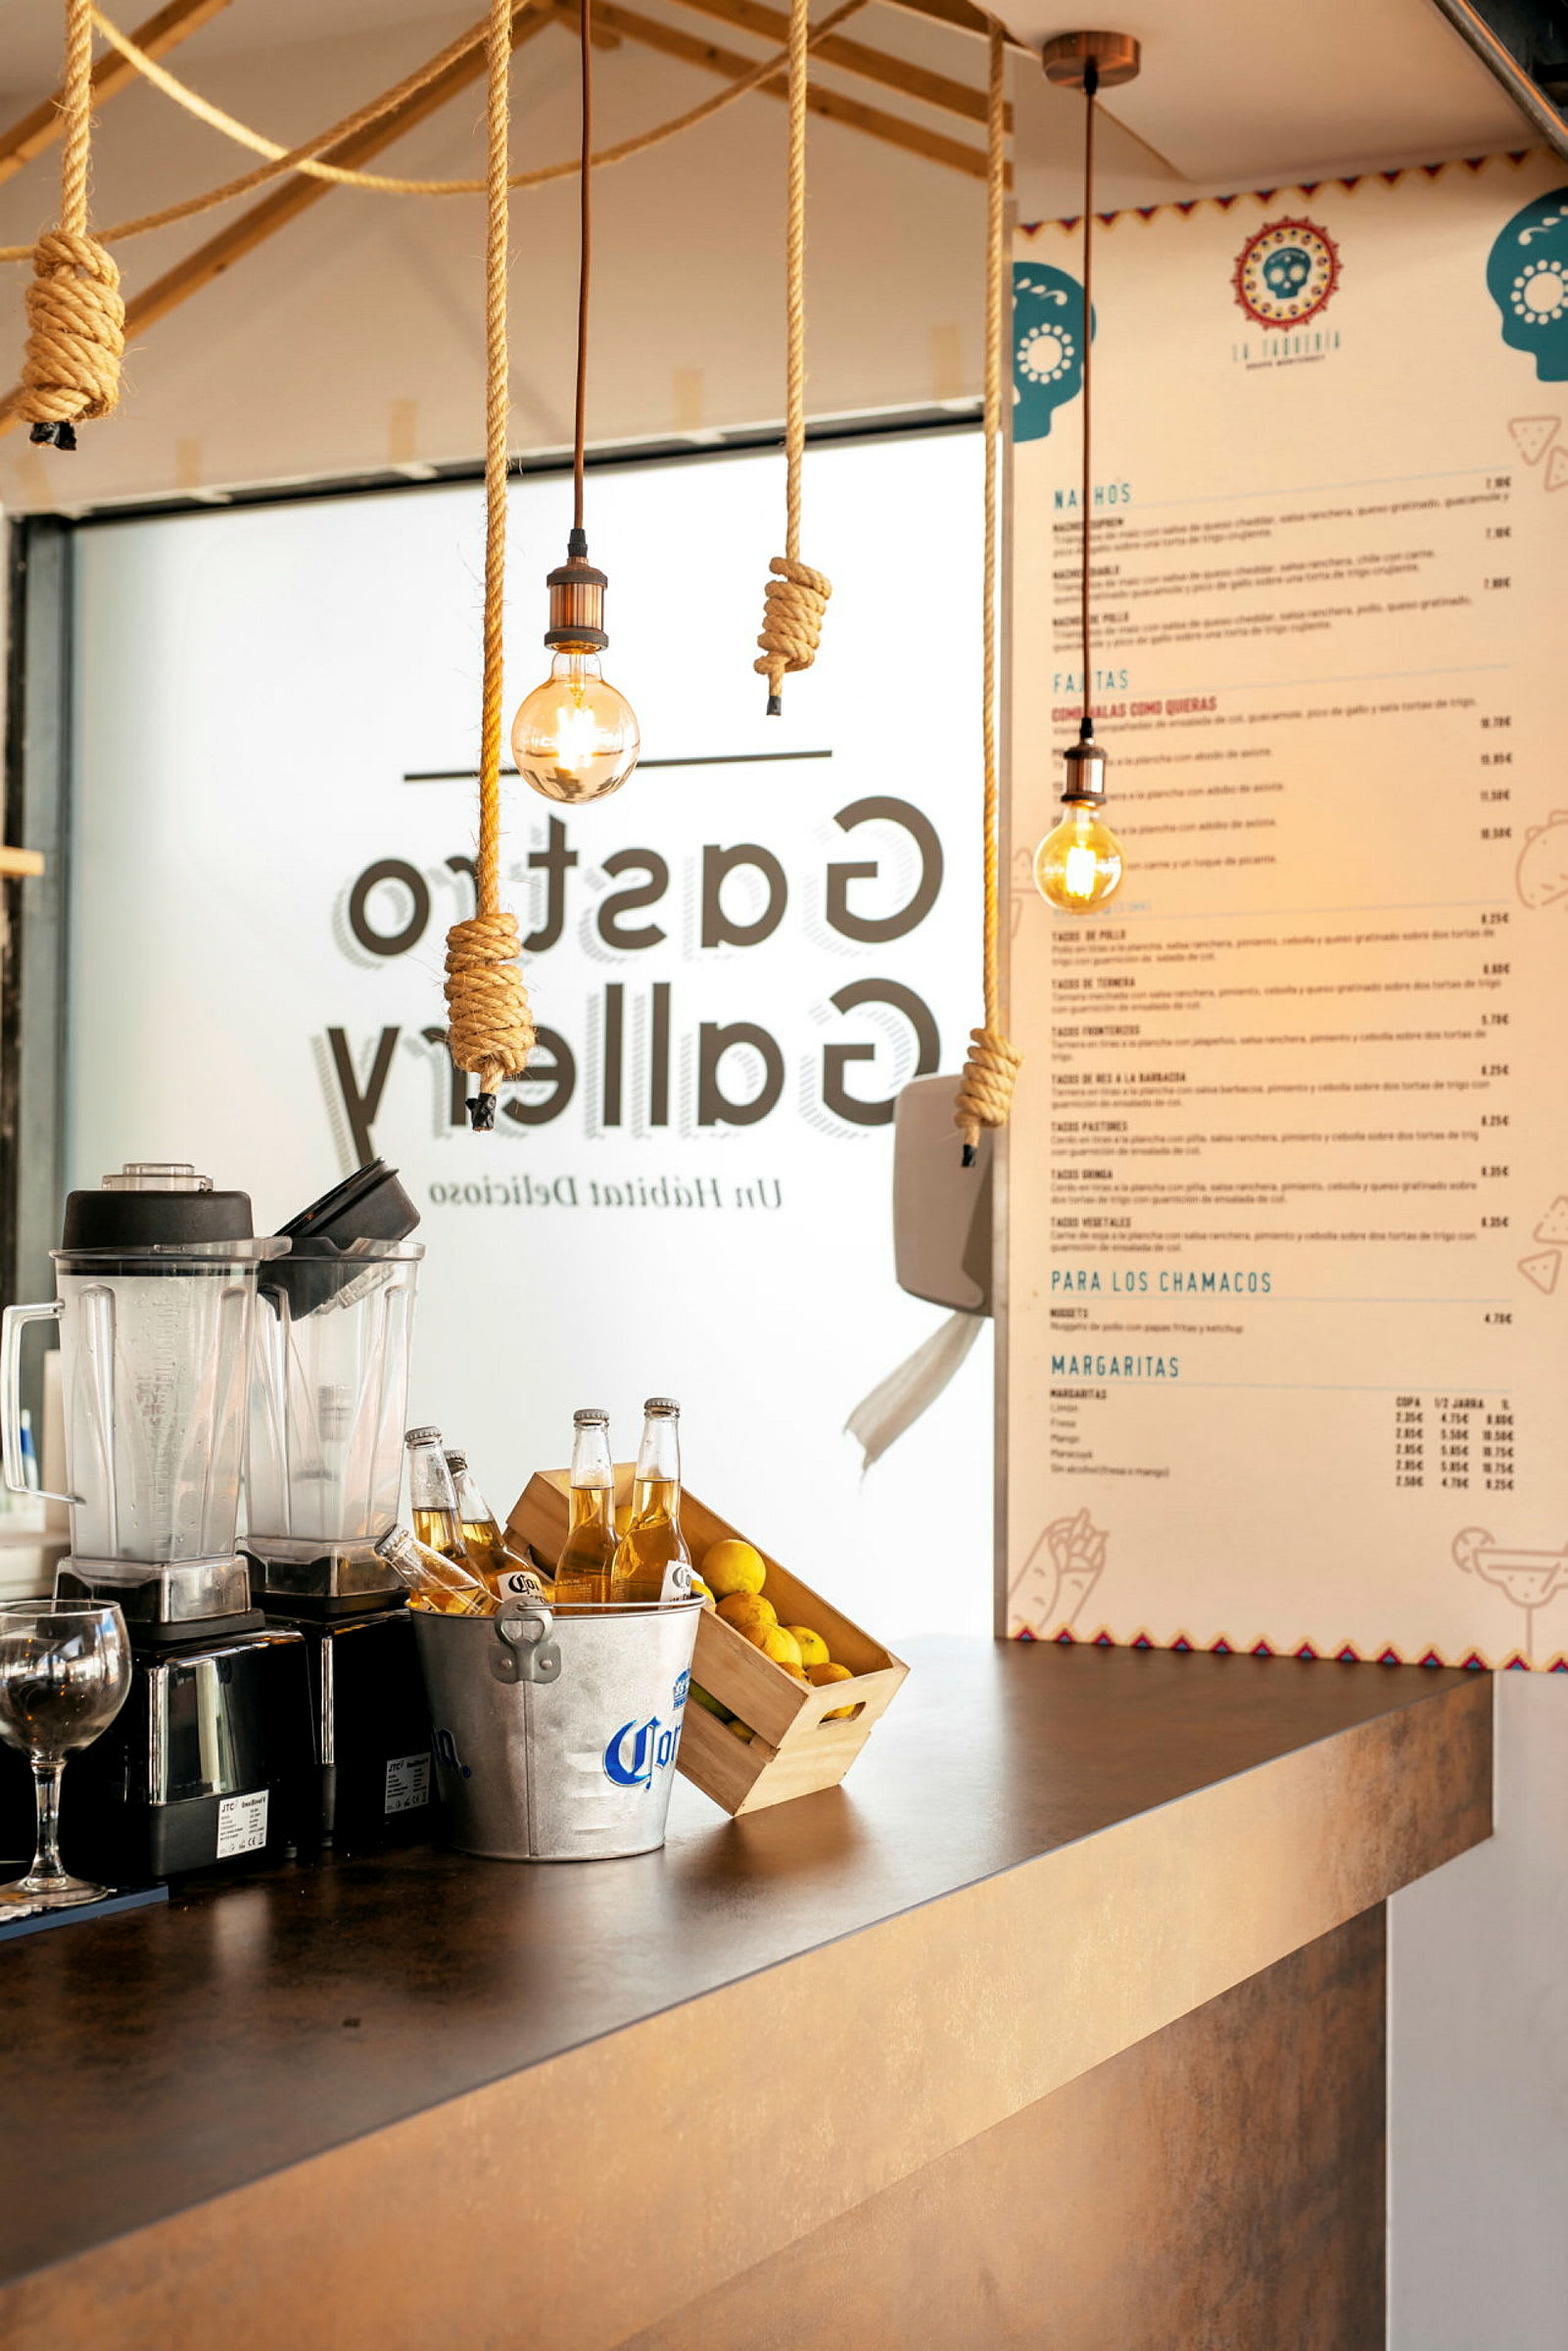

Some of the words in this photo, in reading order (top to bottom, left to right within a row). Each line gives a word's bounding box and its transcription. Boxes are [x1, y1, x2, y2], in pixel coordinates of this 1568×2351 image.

[1054, 484, 1131, 509] NAHOS
[1054, 670, 1128, 693] FAJTAS
[1052, 702, 1126, 722] COMBNALAS
[1130, 700, 1163, 717] COMO
[1165, 696, 1217, 715] QUIERAS
[1051, 1271, 1101, 1291] PARA
[1113, 1271, 1148, 1292] LOS
[1160, 1271, 1272, 1294] CHAMACOS
[1051, 1355, 1180, 1377] MARGARITAS
[1050, 1389, 1107, 1400] MARGARITAS
[1396, 1397, 1420, 1408] COPA
